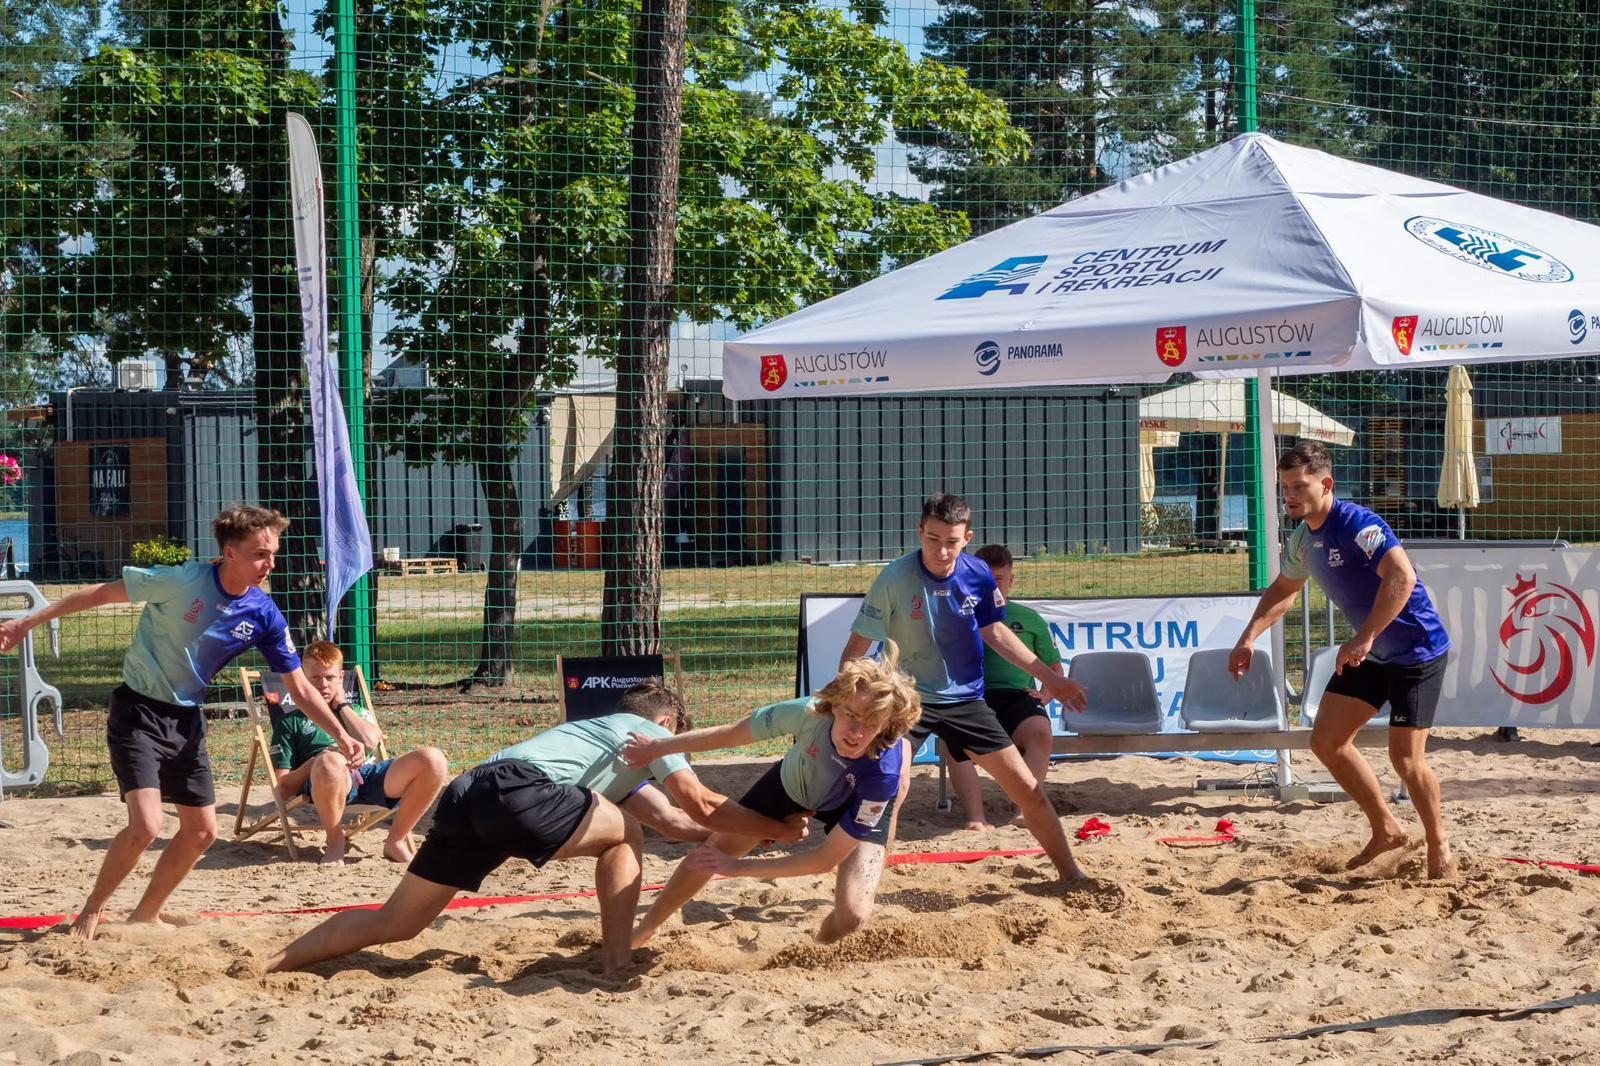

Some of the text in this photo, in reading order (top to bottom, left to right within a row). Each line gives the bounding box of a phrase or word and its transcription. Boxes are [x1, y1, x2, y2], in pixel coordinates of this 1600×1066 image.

[1072, 239, 1229, 265] CENTRUM
[1035, 267, 1225, 294] I REKREACJI
[1053, 257, 1184, 280] SPORTU
[1196, 319, 1314, 347] AUGUSTÓW
[1421, 310, 1504, 337] AUGUSTÓW
[1591, 315, 1600, 330] PA
[794, 347, 888, 374] AUGUSTÓW
[1008, 343, 1063, 360] PANORAMA
[1050, 621, 1199, 650] NTRUM
[581, 676, 611, 688] APK
